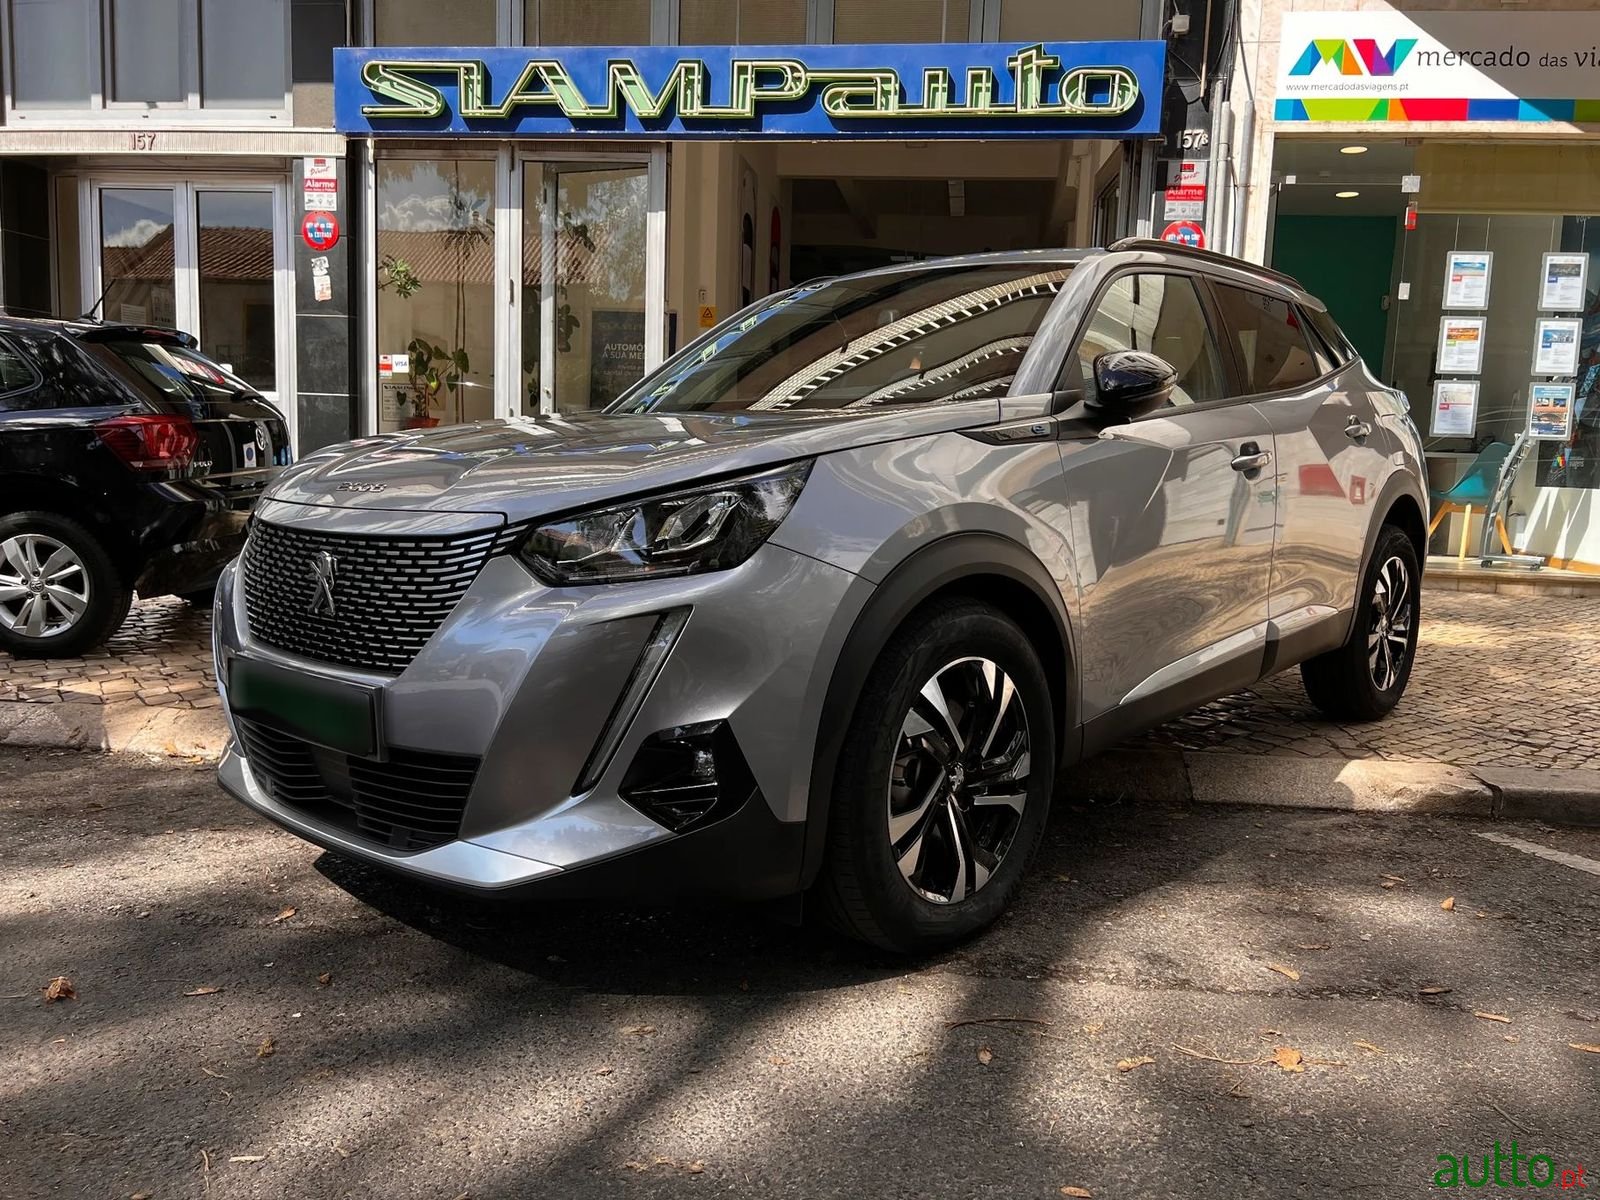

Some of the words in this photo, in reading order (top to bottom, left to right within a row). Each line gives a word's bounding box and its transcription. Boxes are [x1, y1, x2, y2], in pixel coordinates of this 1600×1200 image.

[1417, 45, 1530, 67] mercado
[1539, 52, 1568, 68] das
[1574, 46, 1600, 67] vi
[1286, 82, 1409, 92] www.mercadodasviagens.pt
[131, 132, 157, 151] 157
[305, 179, 335, 188] Alarme
[1167, 187, 1203, 196] Alarme
[603, 342, 645, 352] AUTOMÓ
[629, 352, 645, 360] ME
